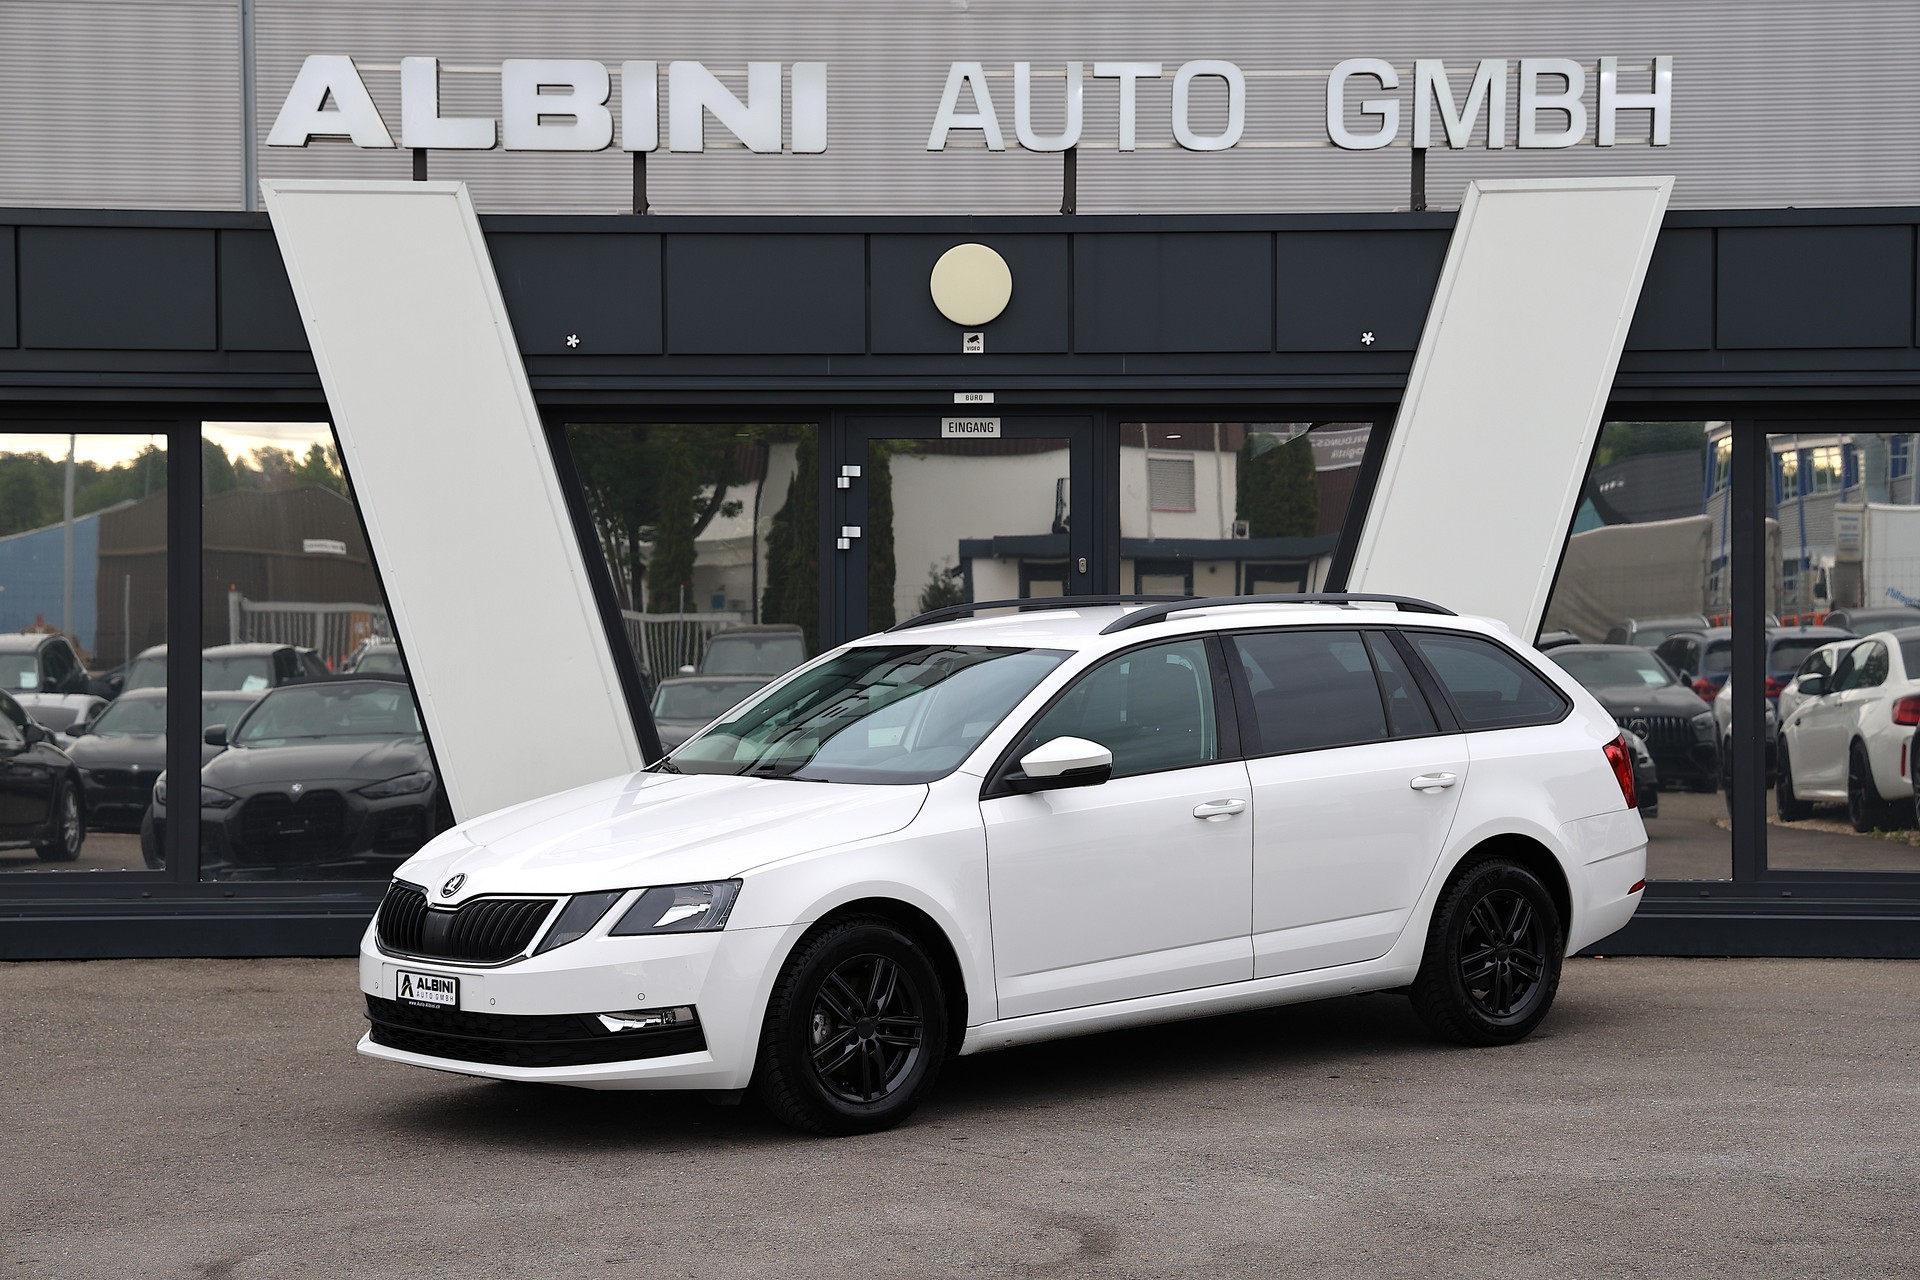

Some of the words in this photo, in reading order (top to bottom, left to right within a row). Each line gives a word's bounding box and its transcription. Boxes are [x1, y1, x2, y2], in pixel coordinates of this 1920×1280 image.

[266, 54, 829, 155] ALBINI
[926, 58, 1247, 153] AUTO
[1326, 55, 1674, 151] GMBH
[948, 422, 994, 433] EINGANG
[417, 977, 454, 994] ALBINI
[417, 991, 432, 999] AUTO
[435, 993, 453, 1002] GMBH
